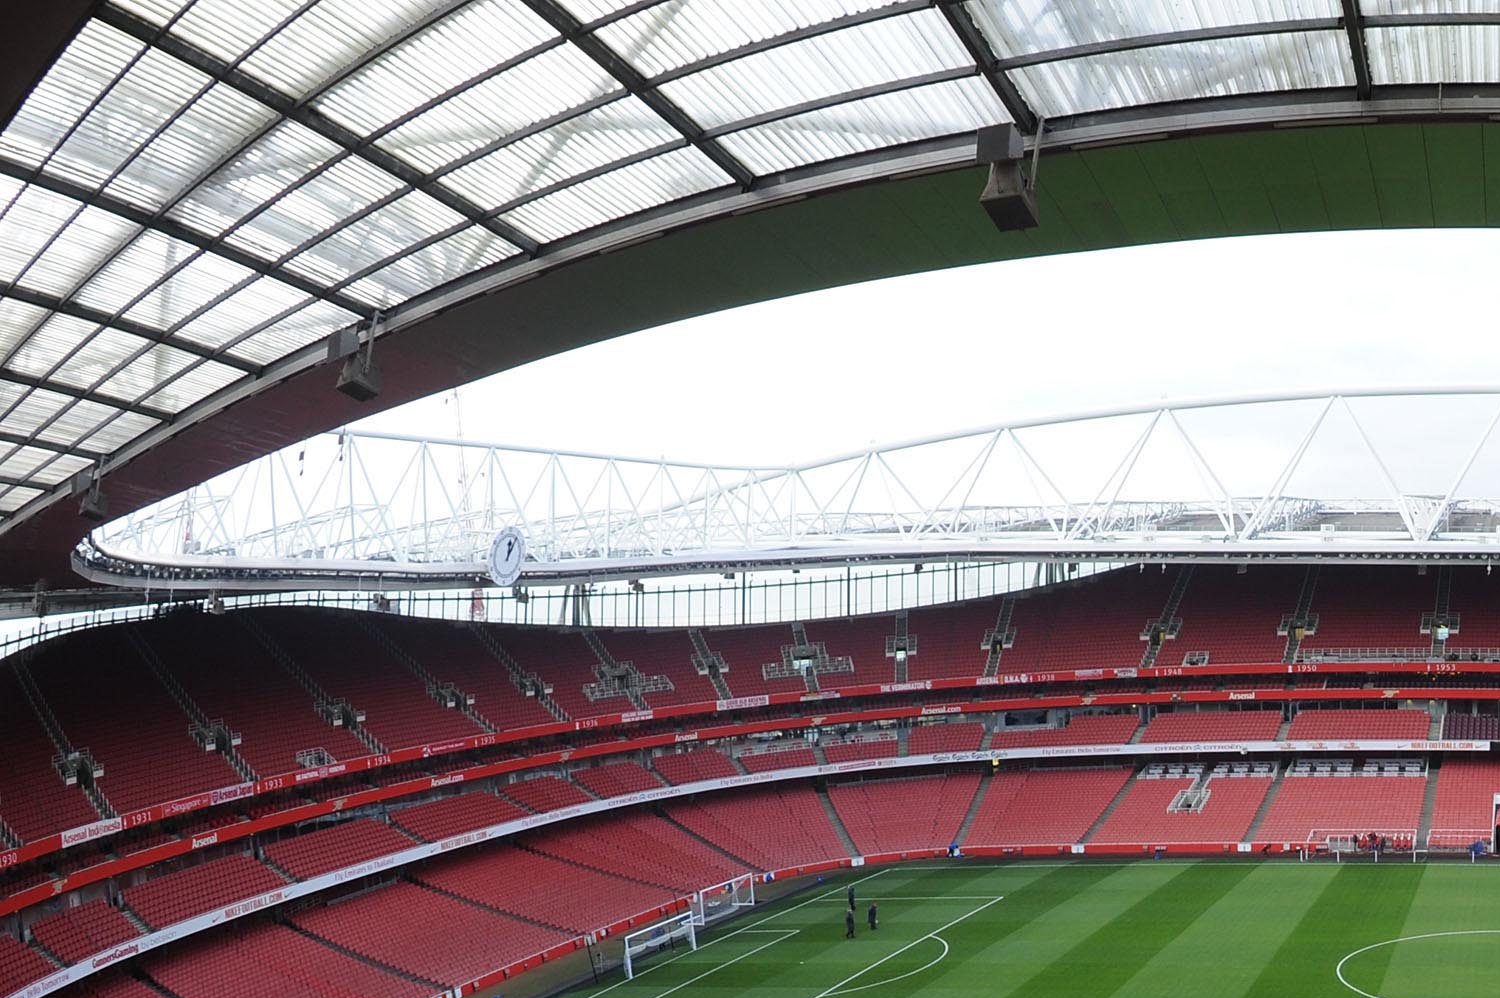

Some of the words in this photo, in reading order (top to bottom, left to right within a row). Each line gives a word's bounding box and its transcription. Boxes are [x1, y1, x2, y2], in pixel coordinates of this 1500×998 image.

[1164, 668, 1183, 676] 1948
[1229, 692, 1255, 701] Arsenal
[921, 705, 962, 715] Arsenal.com
[583, 718, 599, 728] 1936
[481, 735, 496, 745] 1935
[675, 732, 698, 743] Arsenal
[374, 755, 392, 767] 1934
[264, 778, 284, 791] 1933
[431, 774, 464, 788] Arsenal.com
[132, 812, 152, 826] 1931
[63, 828, 88, 844] Arsenal
[192, 832, 218, 849] Arsenal
